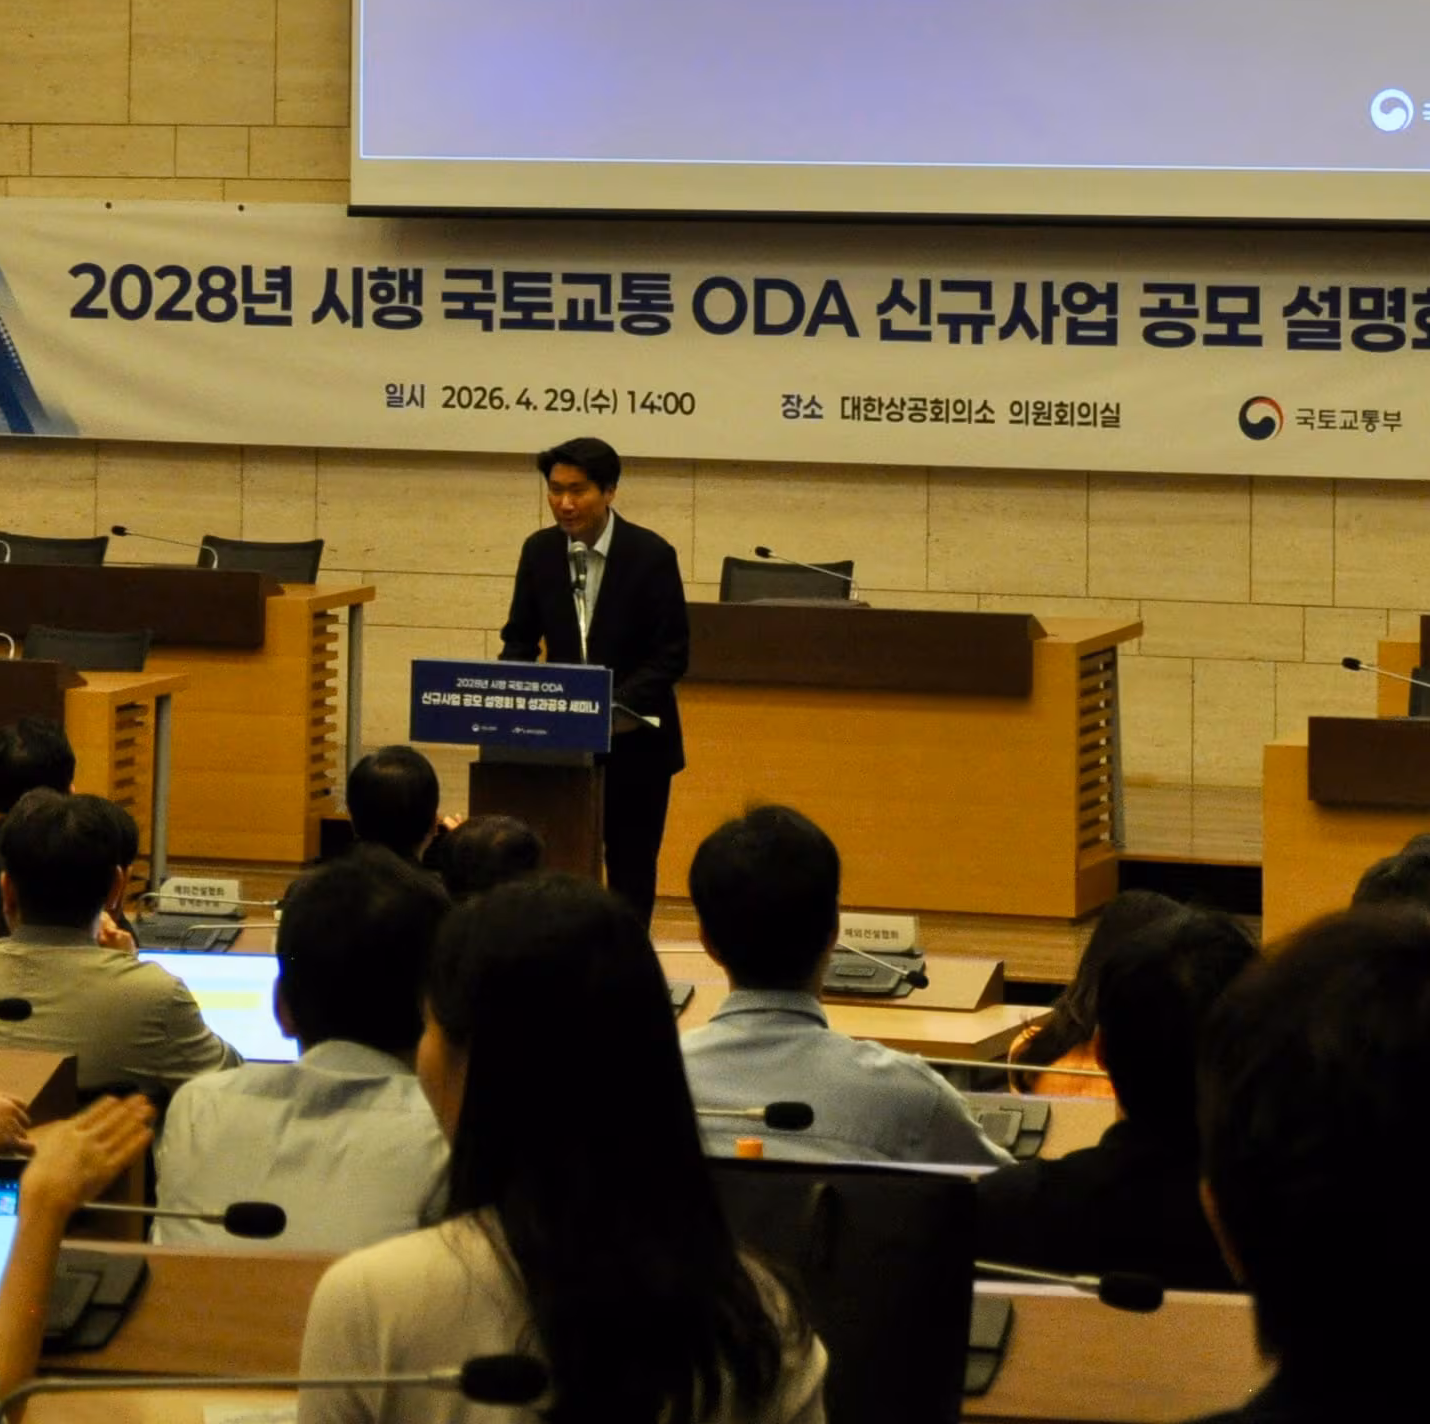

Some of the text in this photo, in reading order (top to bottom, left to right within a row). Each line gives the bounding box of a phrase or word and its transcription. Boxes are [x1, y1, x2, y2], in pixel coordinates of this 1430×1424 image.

[67, 262, 293, 327] 2028년
[311, 266, 423, 330] 시행
[441, 268, 674, 336] 국토교통
[692, 276, 860, 338] ODA
[876, 278, 1118, 346] 신규사업
[1139, 282, 1263, 348] 공모
[385, 383, 425, 409] 일시
[626, 390, 695, 416] 14:00
[781, 394, 1121, 428] 장소 대한상공회의소 의원회의실
[1295, 408, 1403, 433] 국토교통부
[456, 678, 488, 689] 2028년
[508, 680, 540, 692] 국토교통
[541, 682, 563, 693] ODA
[422, 692, 460, 706] 신규사업
[463, 694, 482, 707] 공모
[484, 695, 514, 709] 설명회
[528, 698, 567, 712] 성과공유
[569, 700, 600, 714] 세미나
